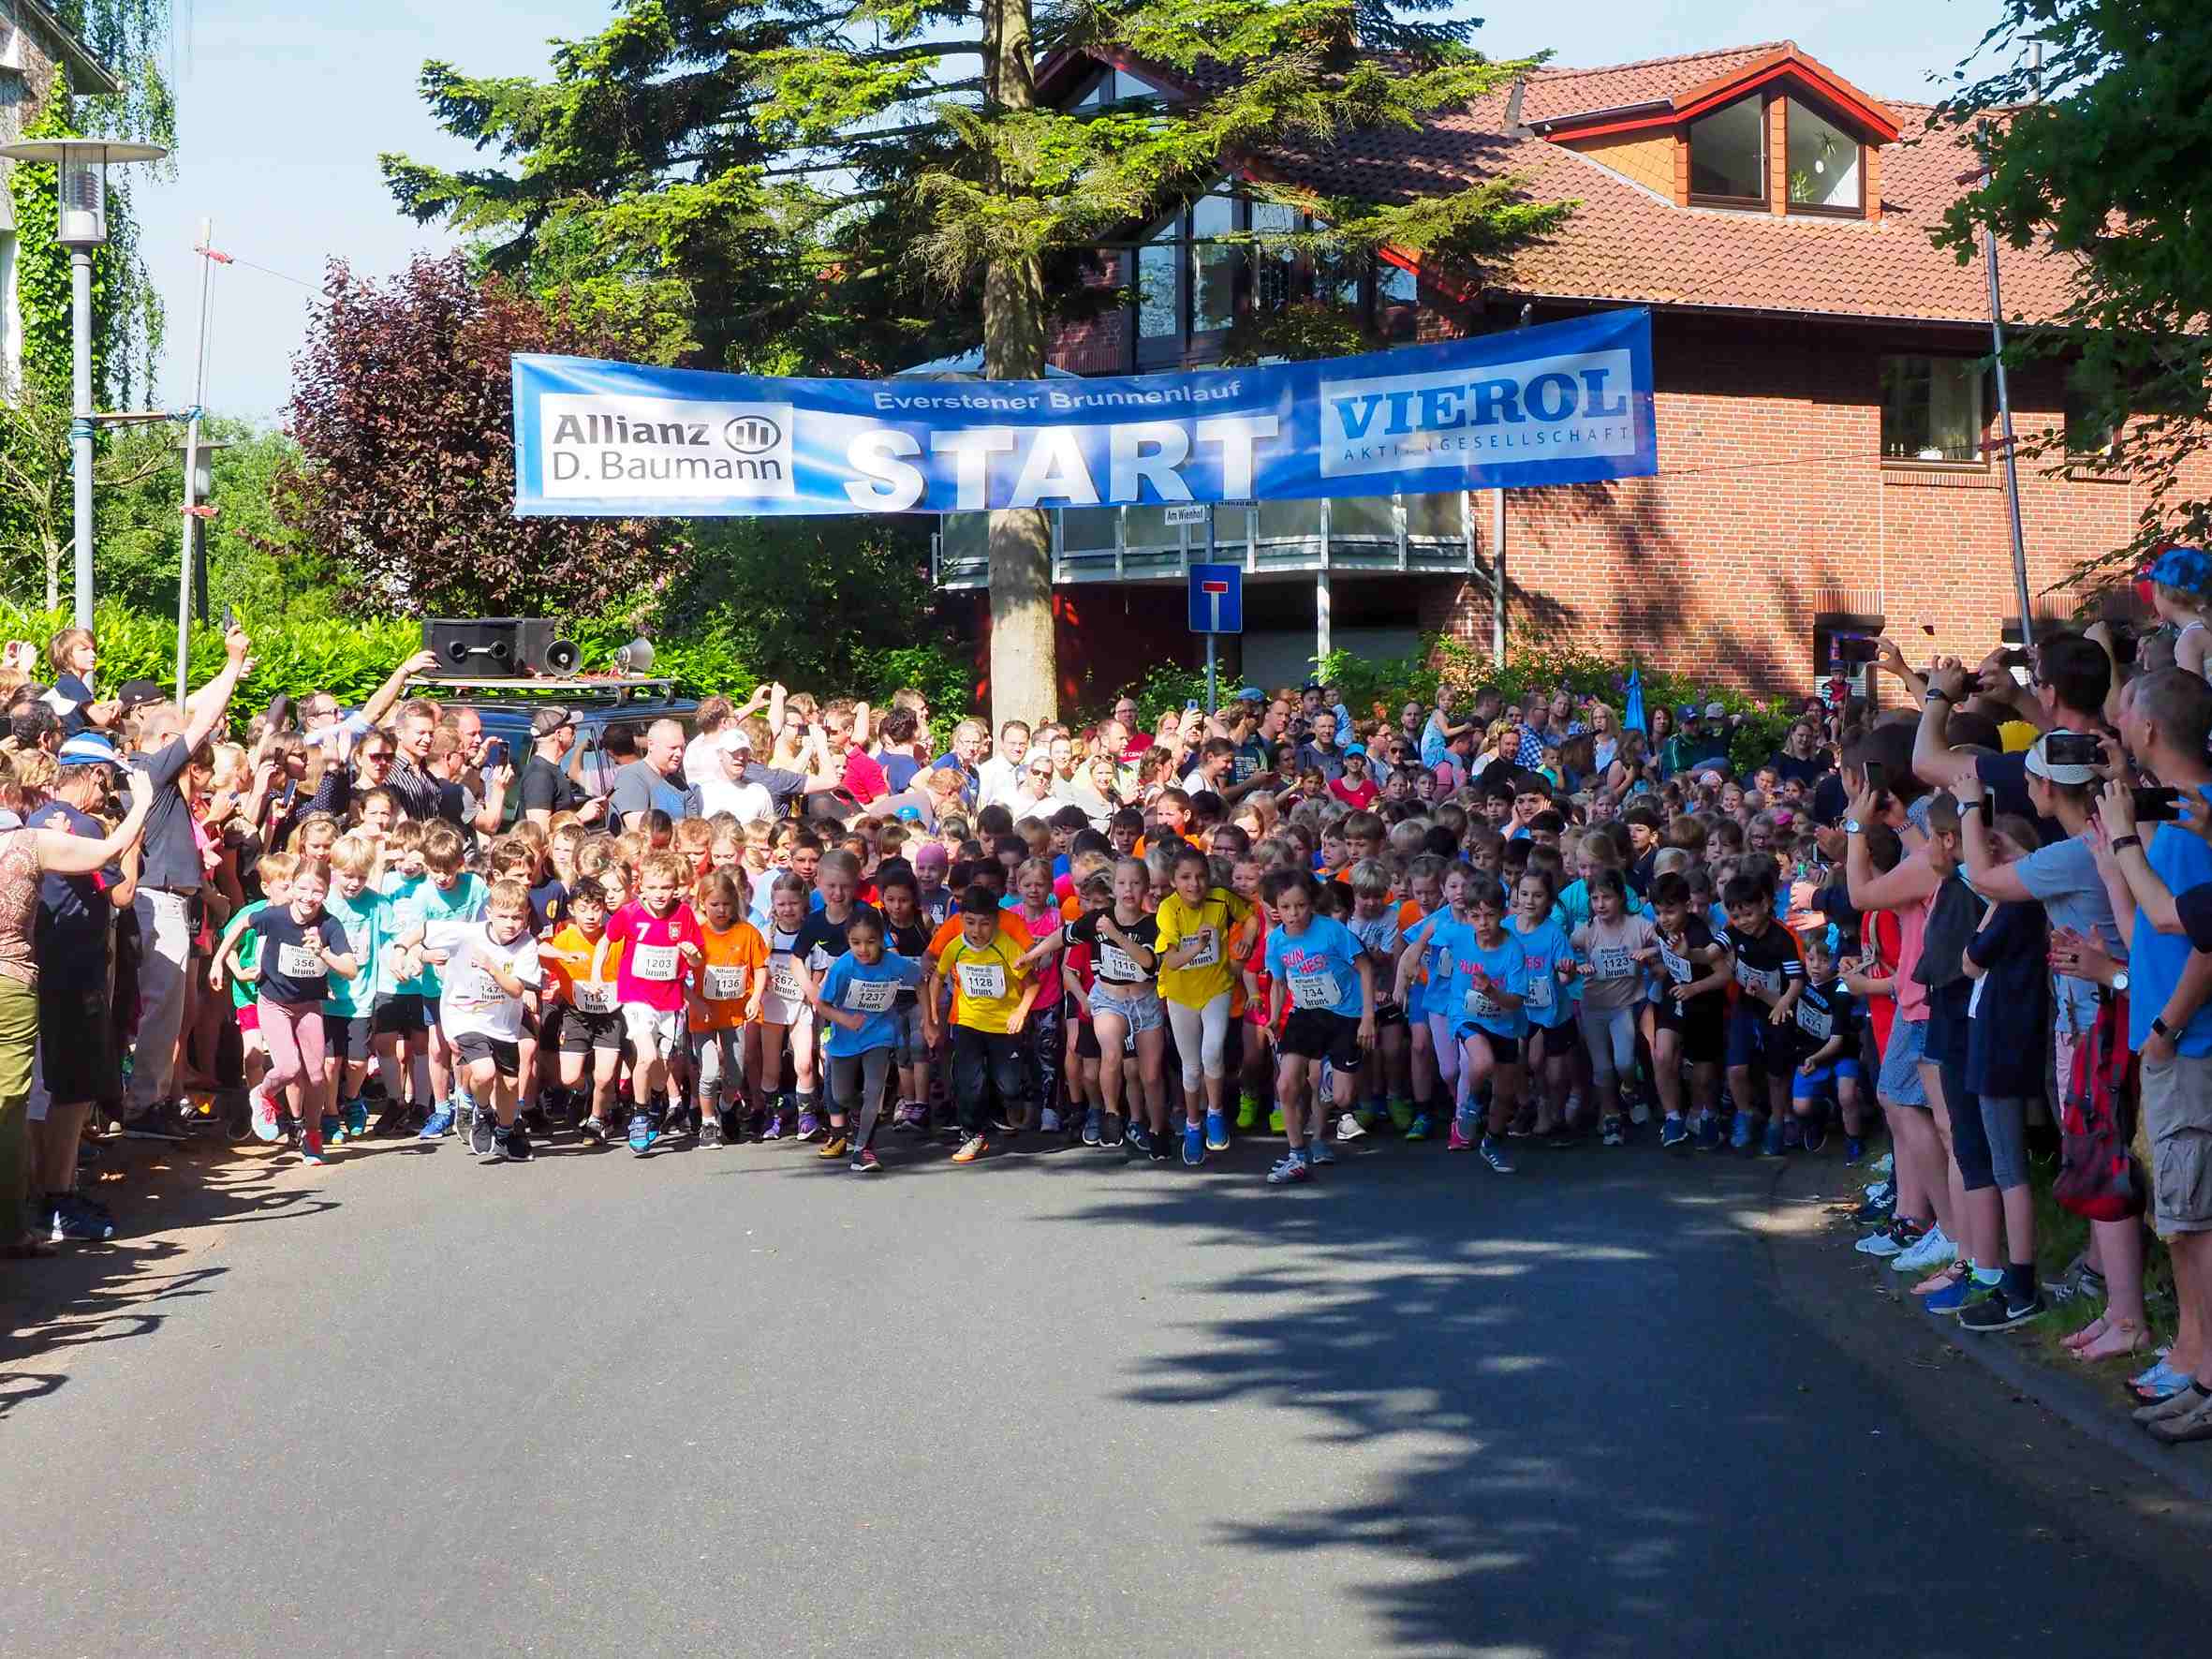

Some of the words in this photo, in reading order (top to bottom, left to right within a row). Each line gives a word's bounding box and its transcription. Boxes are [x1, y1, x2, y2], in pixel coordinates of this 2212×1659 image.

[874, 392, 1040, 410] Everstener
[1051, 380, 1241, 409] Brunnenlauf
[1332, 369, 1628, 439] VIEROL
[553, 414, 710, 445] Allianz
[553, 452, 590, 480] D.
[601, 451, 782, 480] Baumann
[844, 416, 1280, 511] START
[1168, 510, 1177, 521] Am
[636, 922, 651, 941] 7
[294, 957, 316, 967] 356
[646, 958, 672, 968] 1203
[968, 977, 994, 987] 1128
[861, 992, 886, 1001] 1237
